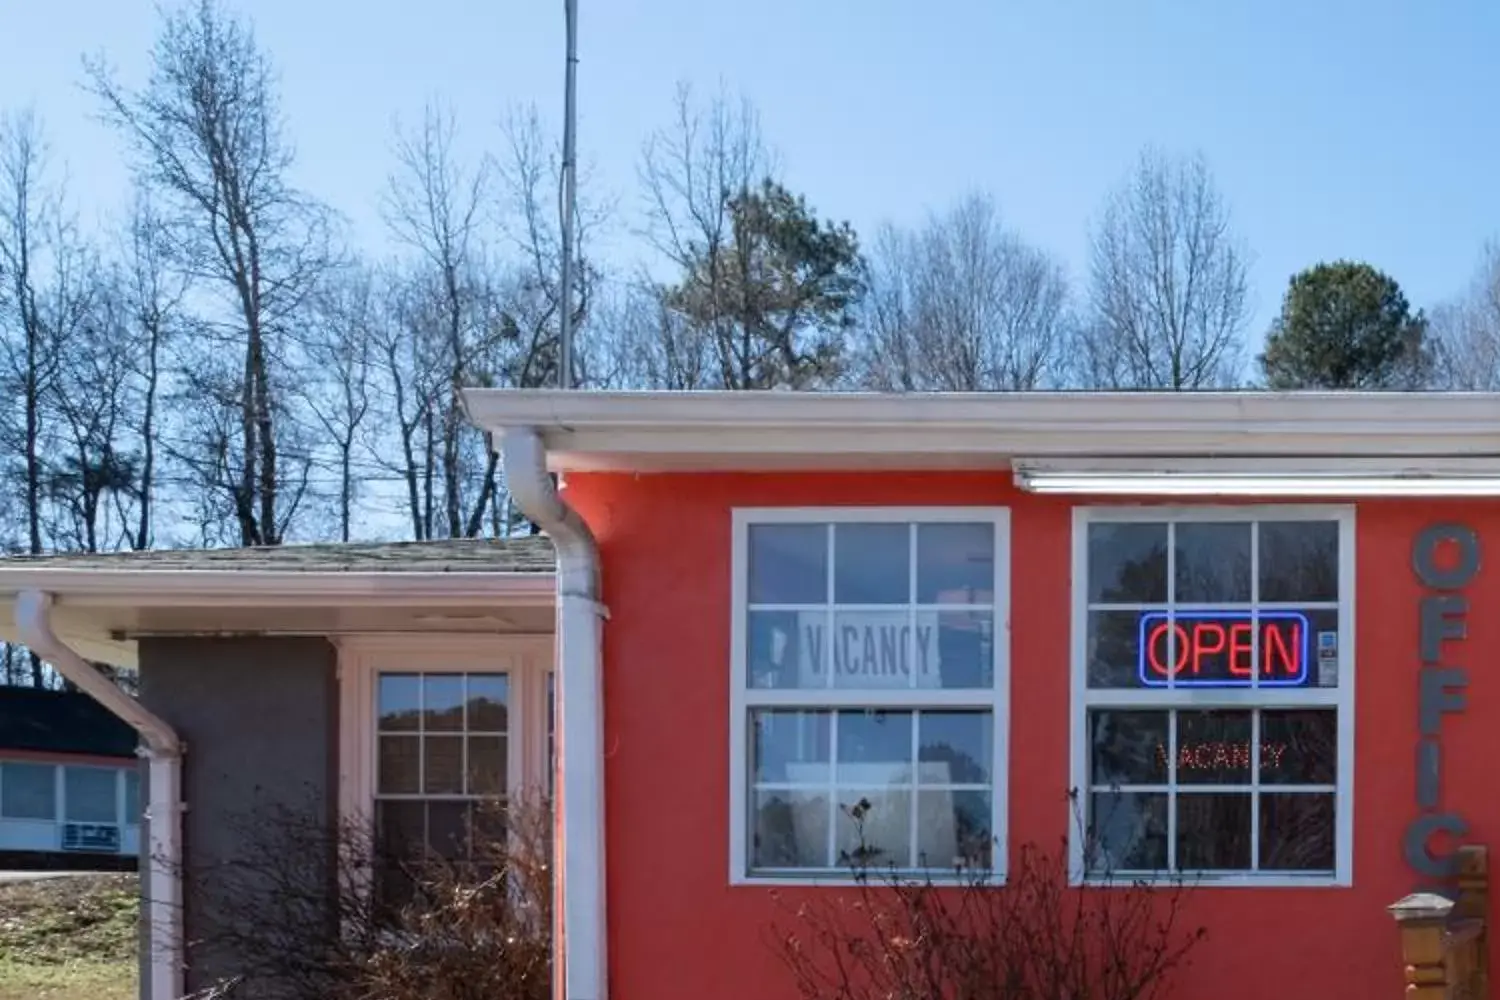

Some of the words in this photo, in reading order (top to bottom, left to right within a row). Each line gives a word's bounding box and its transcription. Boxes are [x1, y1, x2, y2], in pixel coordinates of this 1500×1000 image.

[806, 624, 931, 676] VACANCY
[1148, 622, 1299, 676] OPEN
[1402, 522, 1481, 898] OFFIC
